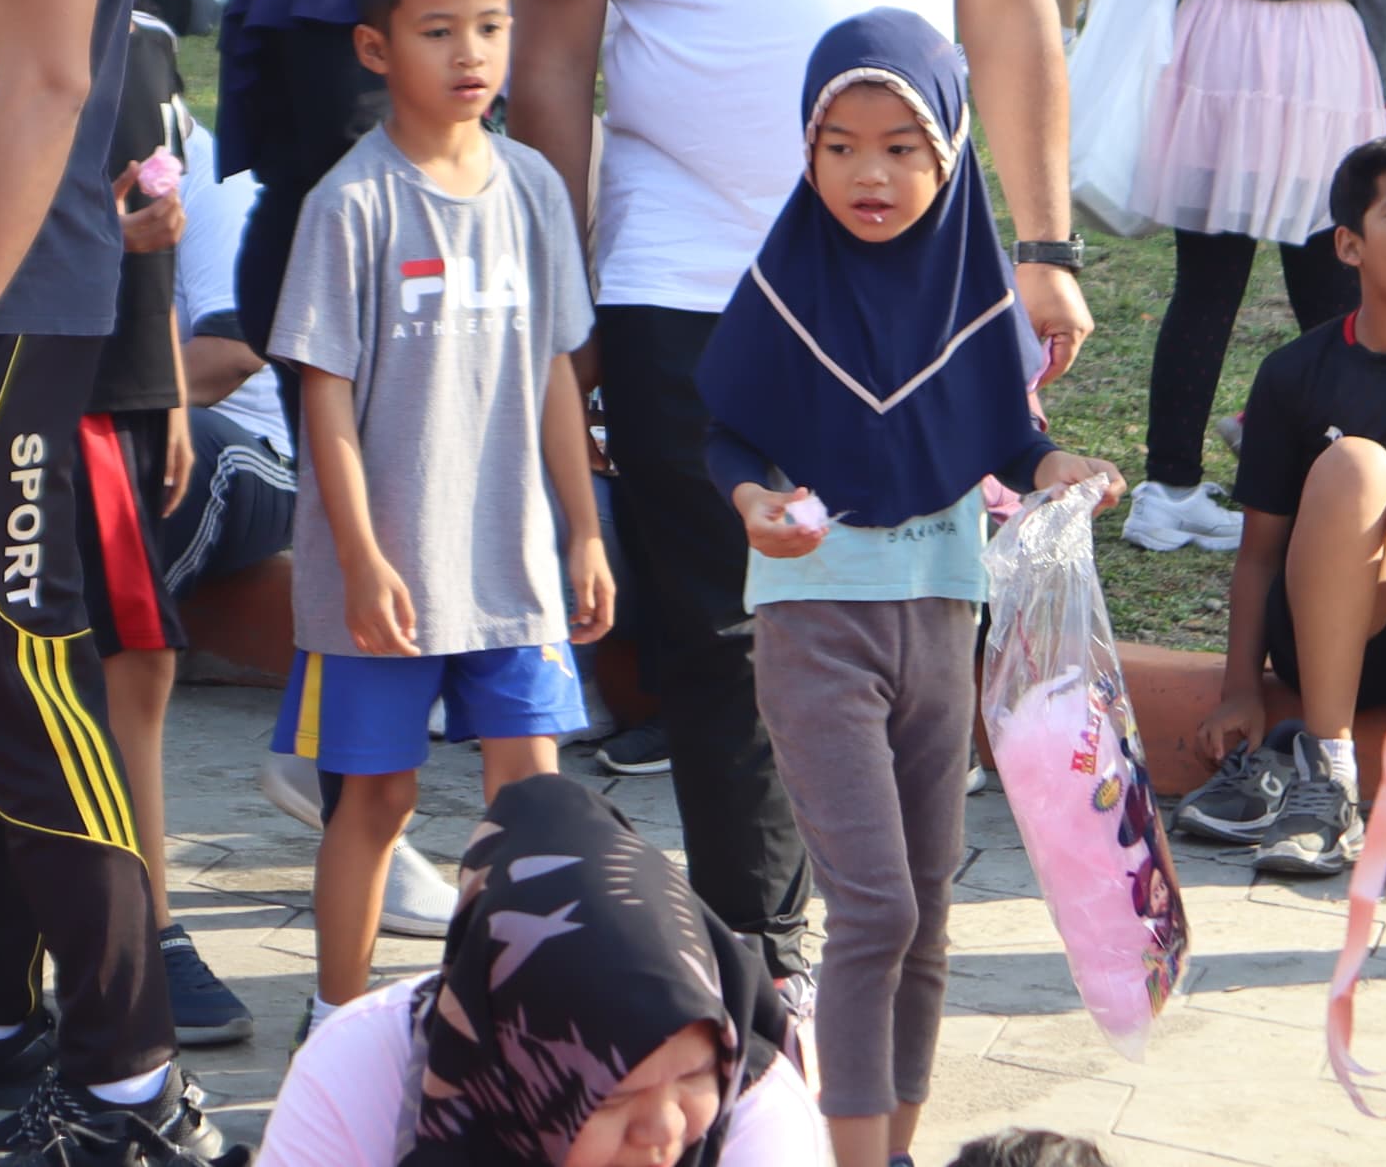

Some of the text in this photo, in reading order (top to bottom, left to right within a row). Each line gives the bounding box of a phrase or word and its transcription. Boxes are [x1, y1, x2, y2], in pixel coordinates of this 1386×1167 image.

[400, 254, 530, 314] FILA
[392, 315, 527, 339] ATHLETIC
[4, 433, 45, 608] SPORT
